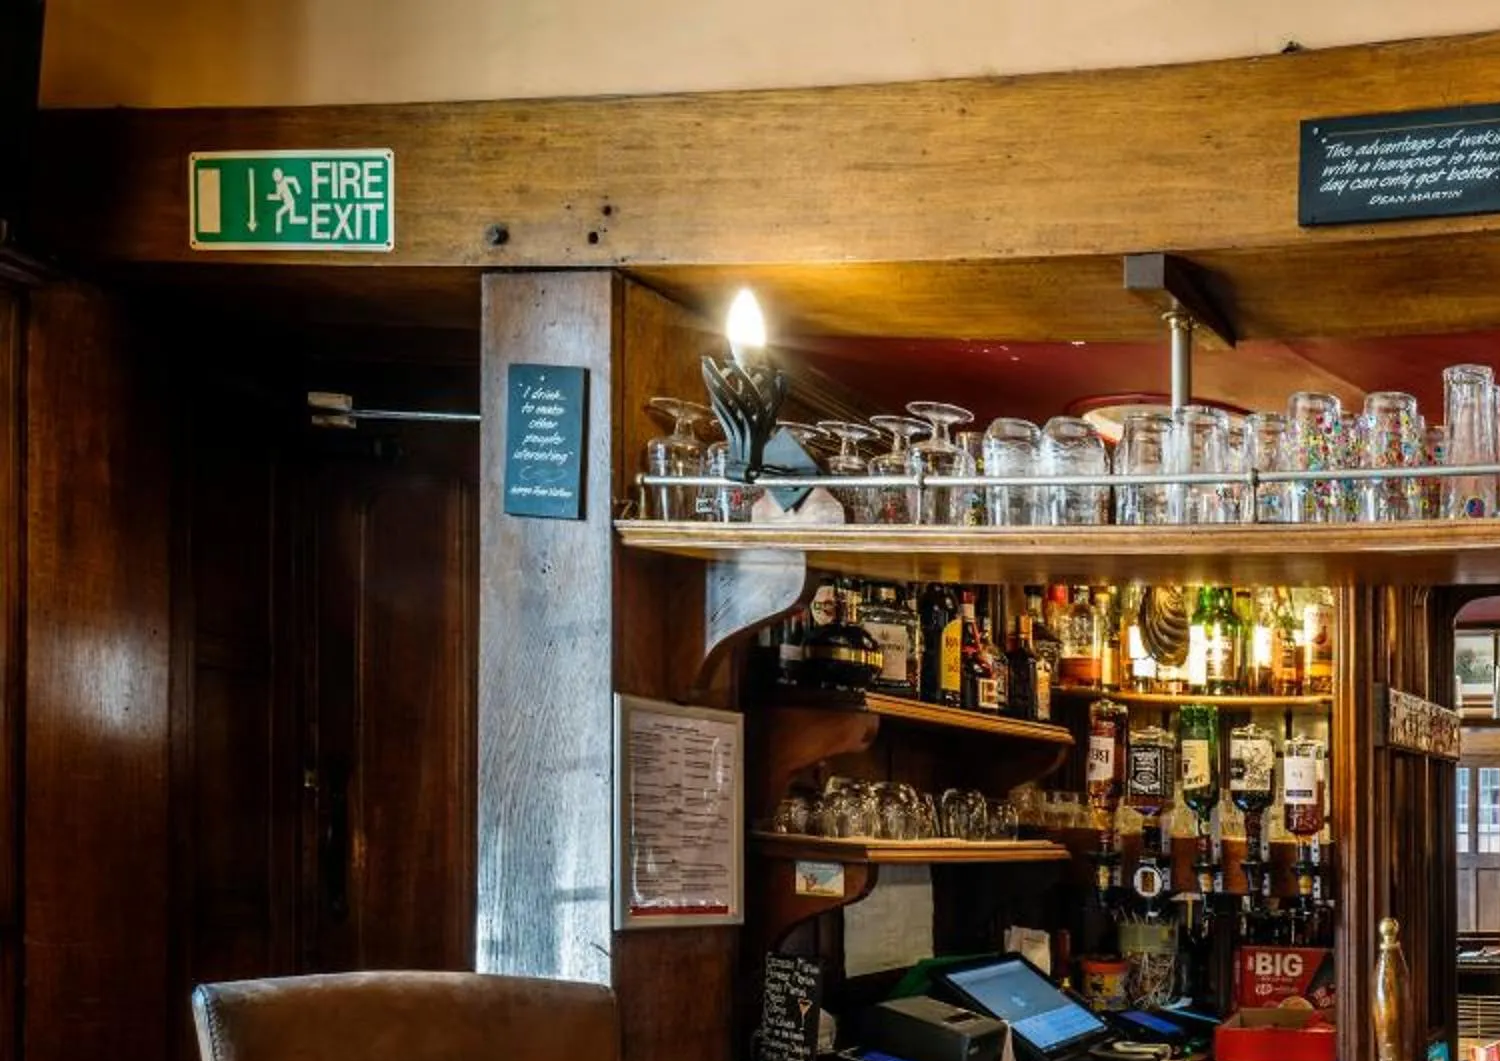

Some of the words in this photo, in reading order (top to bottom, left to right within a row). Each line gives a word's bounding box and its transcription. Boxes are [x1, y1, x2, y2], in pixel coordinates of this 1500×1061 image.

[1355, 135, 1436, 157] advantage
[1438, 129, 1464, 149] of
[1322, 160, 1358, 176] with
[1359, 162, 1371, 173] a
[1372, 154, 1447, 173] hangover
[1447, 152, 1465, 165] is
[311, 161, 385, 199] FIRE
[1320, 178, 1348, 196] day
[1350, 178, 1379, 191] can
[1379, 172, 1416, 190] only
[1415, 168, 1446, 189] get
[311, 203, 385, 241] EXIT
[1256, 954, 1304, 977] BIG
